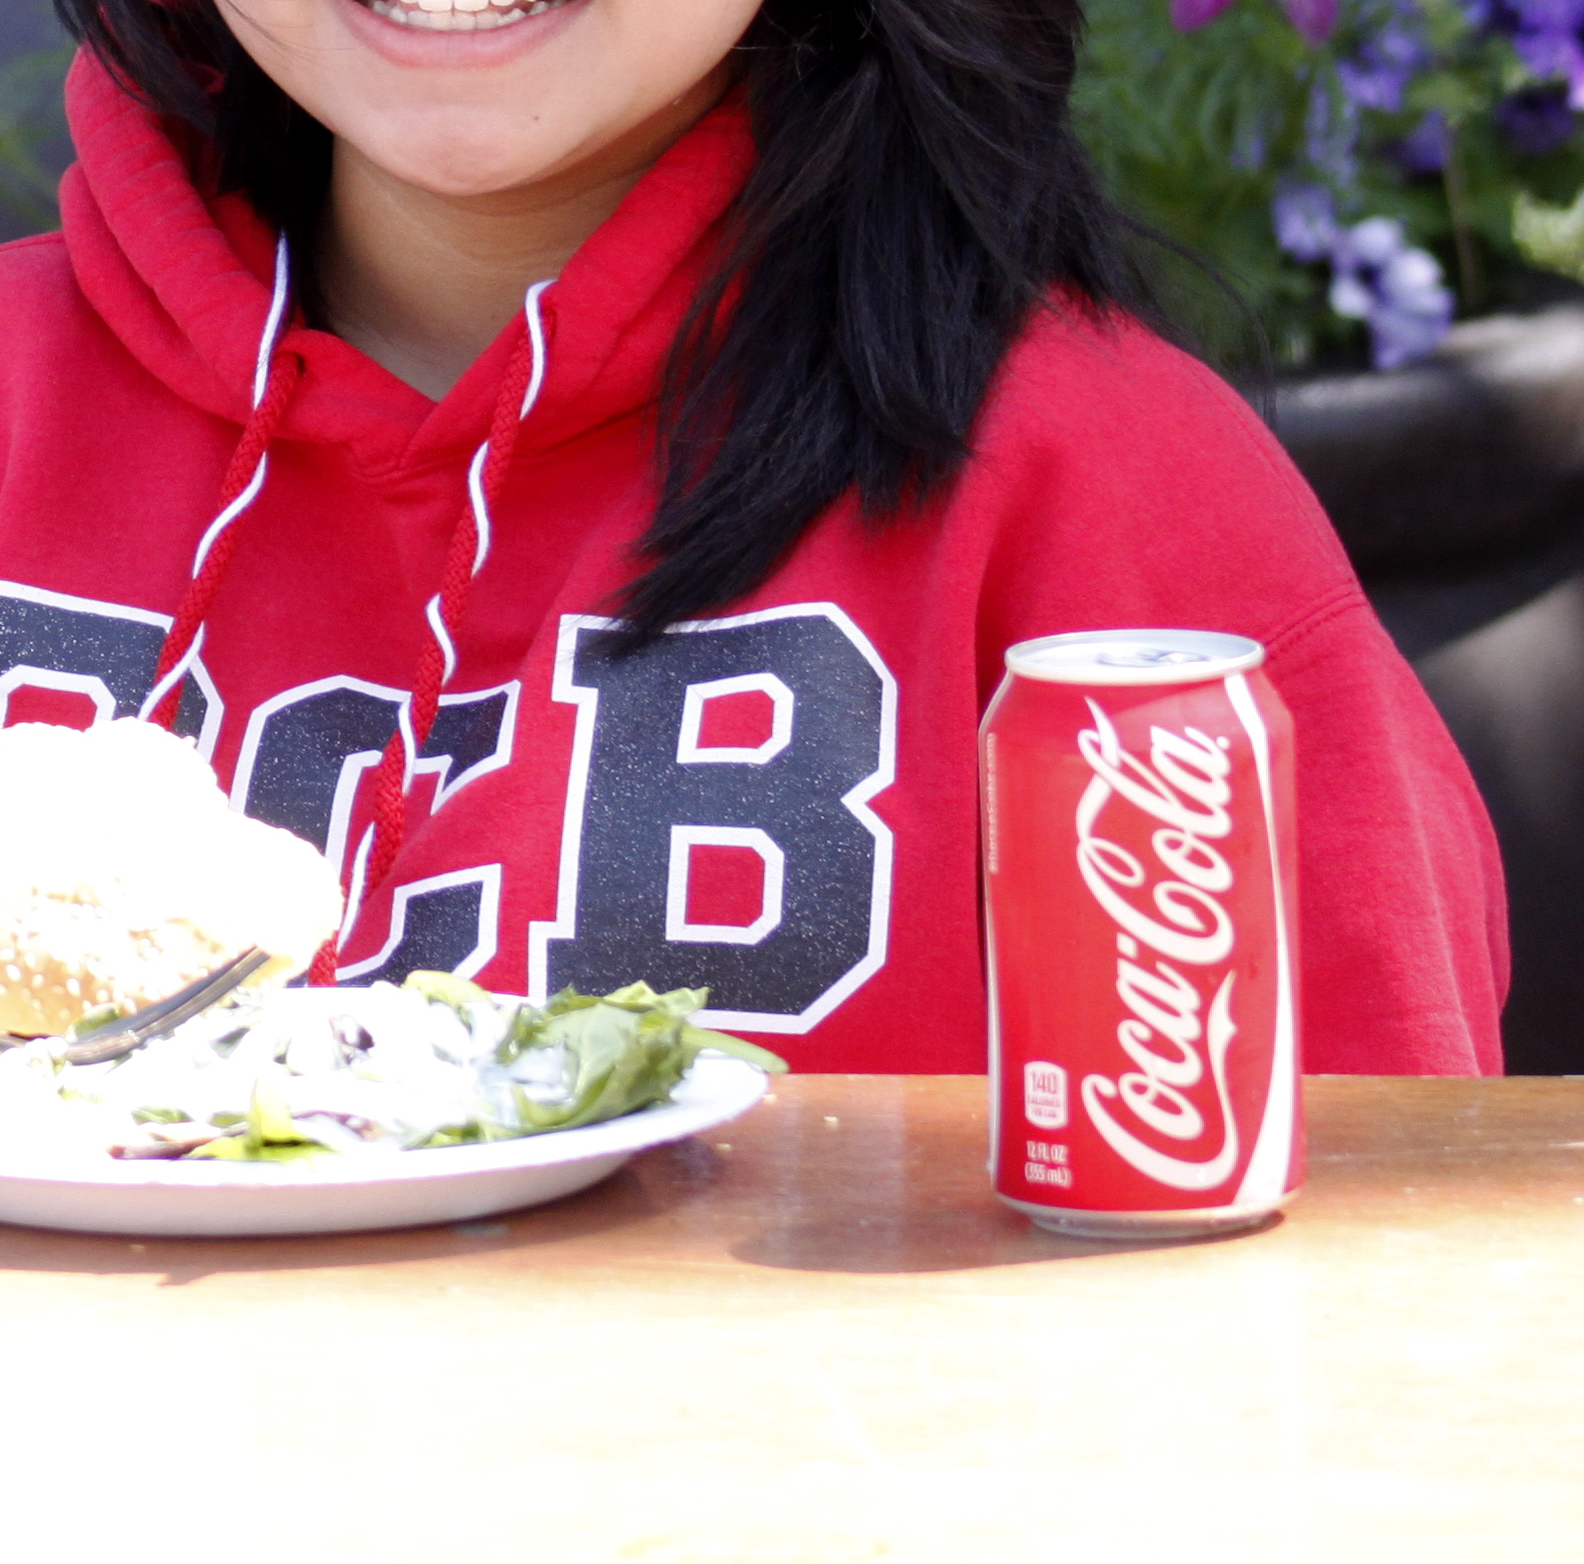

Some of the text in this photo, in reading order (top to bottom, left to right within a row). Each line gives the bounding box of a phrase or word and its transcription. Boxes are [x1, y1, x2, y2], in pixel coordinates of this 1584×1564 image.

[1075, 694, 1237, 1191] Coca-Cola
[1031, 1071, 1058, 1095] 140
[1026, 1140, 1036, 1160] 12
[1037, 1142, 1050, 1163] FL
